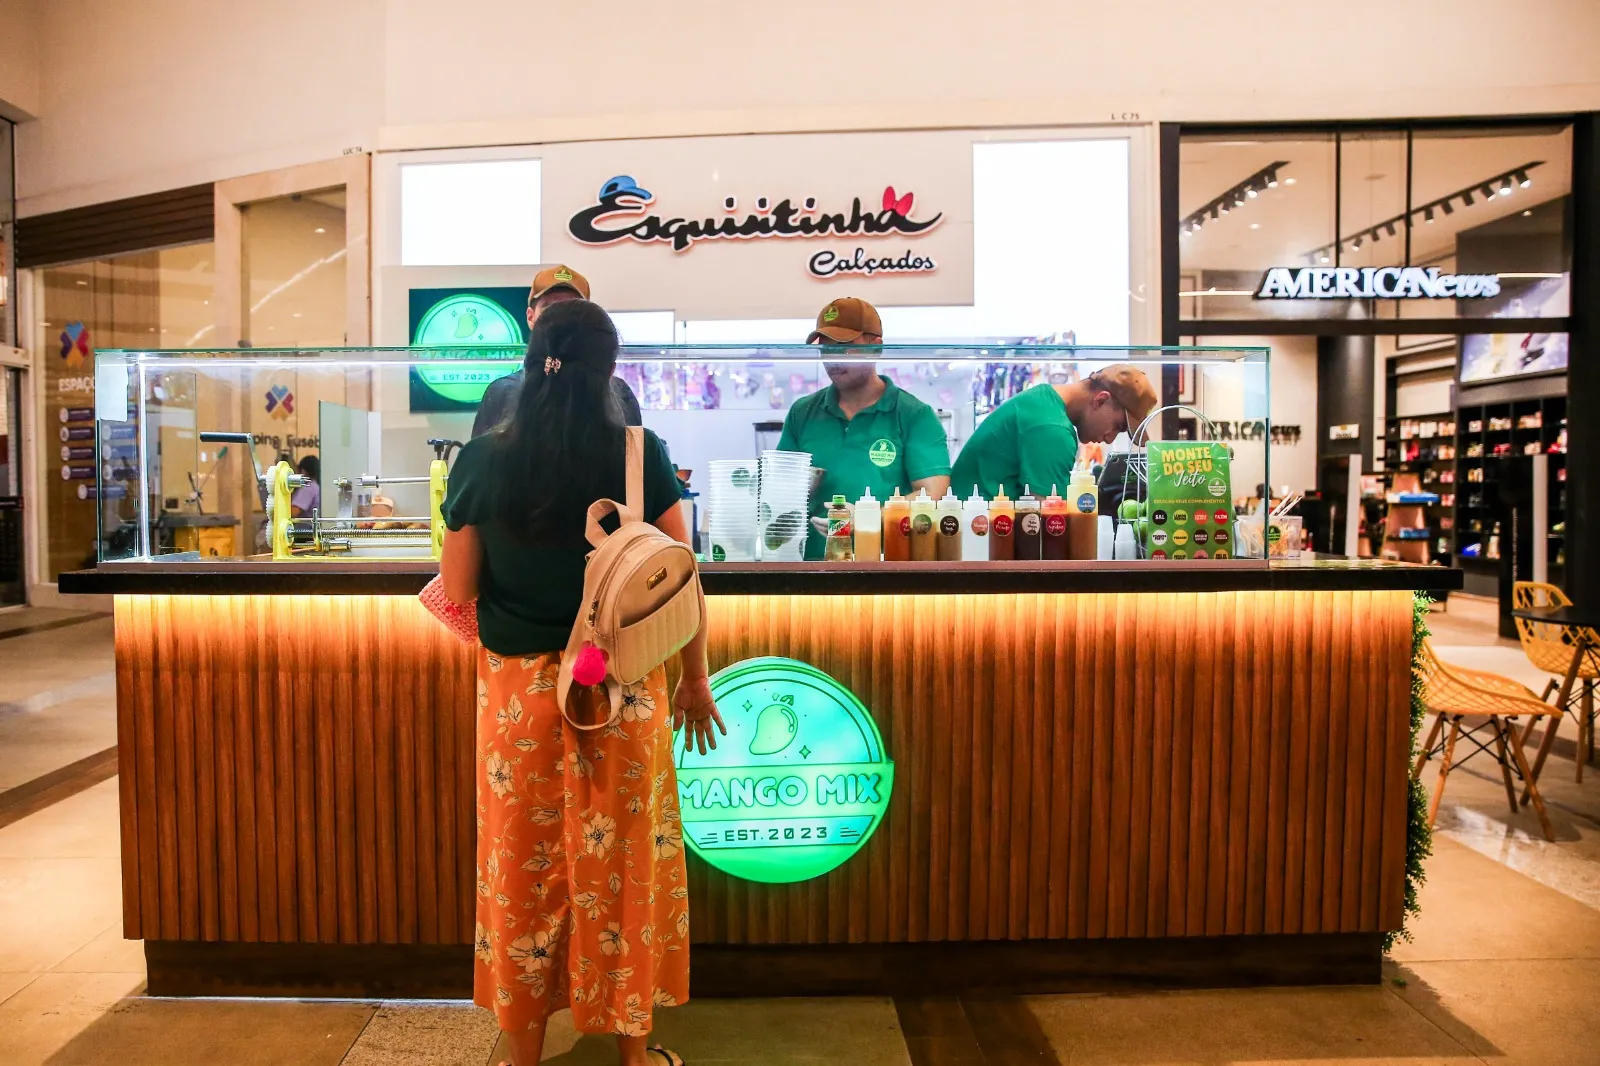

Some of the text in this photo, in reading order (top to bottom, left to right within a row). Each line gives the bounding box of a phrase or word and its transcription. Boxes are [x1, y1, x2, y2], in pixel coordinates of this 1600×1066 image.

[808, 249, 935, 275] Calçados
[1257, 266, 1500, 299] AMERICANews
[1161, 447, 1212, 463] MONTE
[1163, 459, 1213, 476] DO SEU
[1173, 469, 1207, 488] Jeito
[677, 773, 882, 809] MANGO MIX
